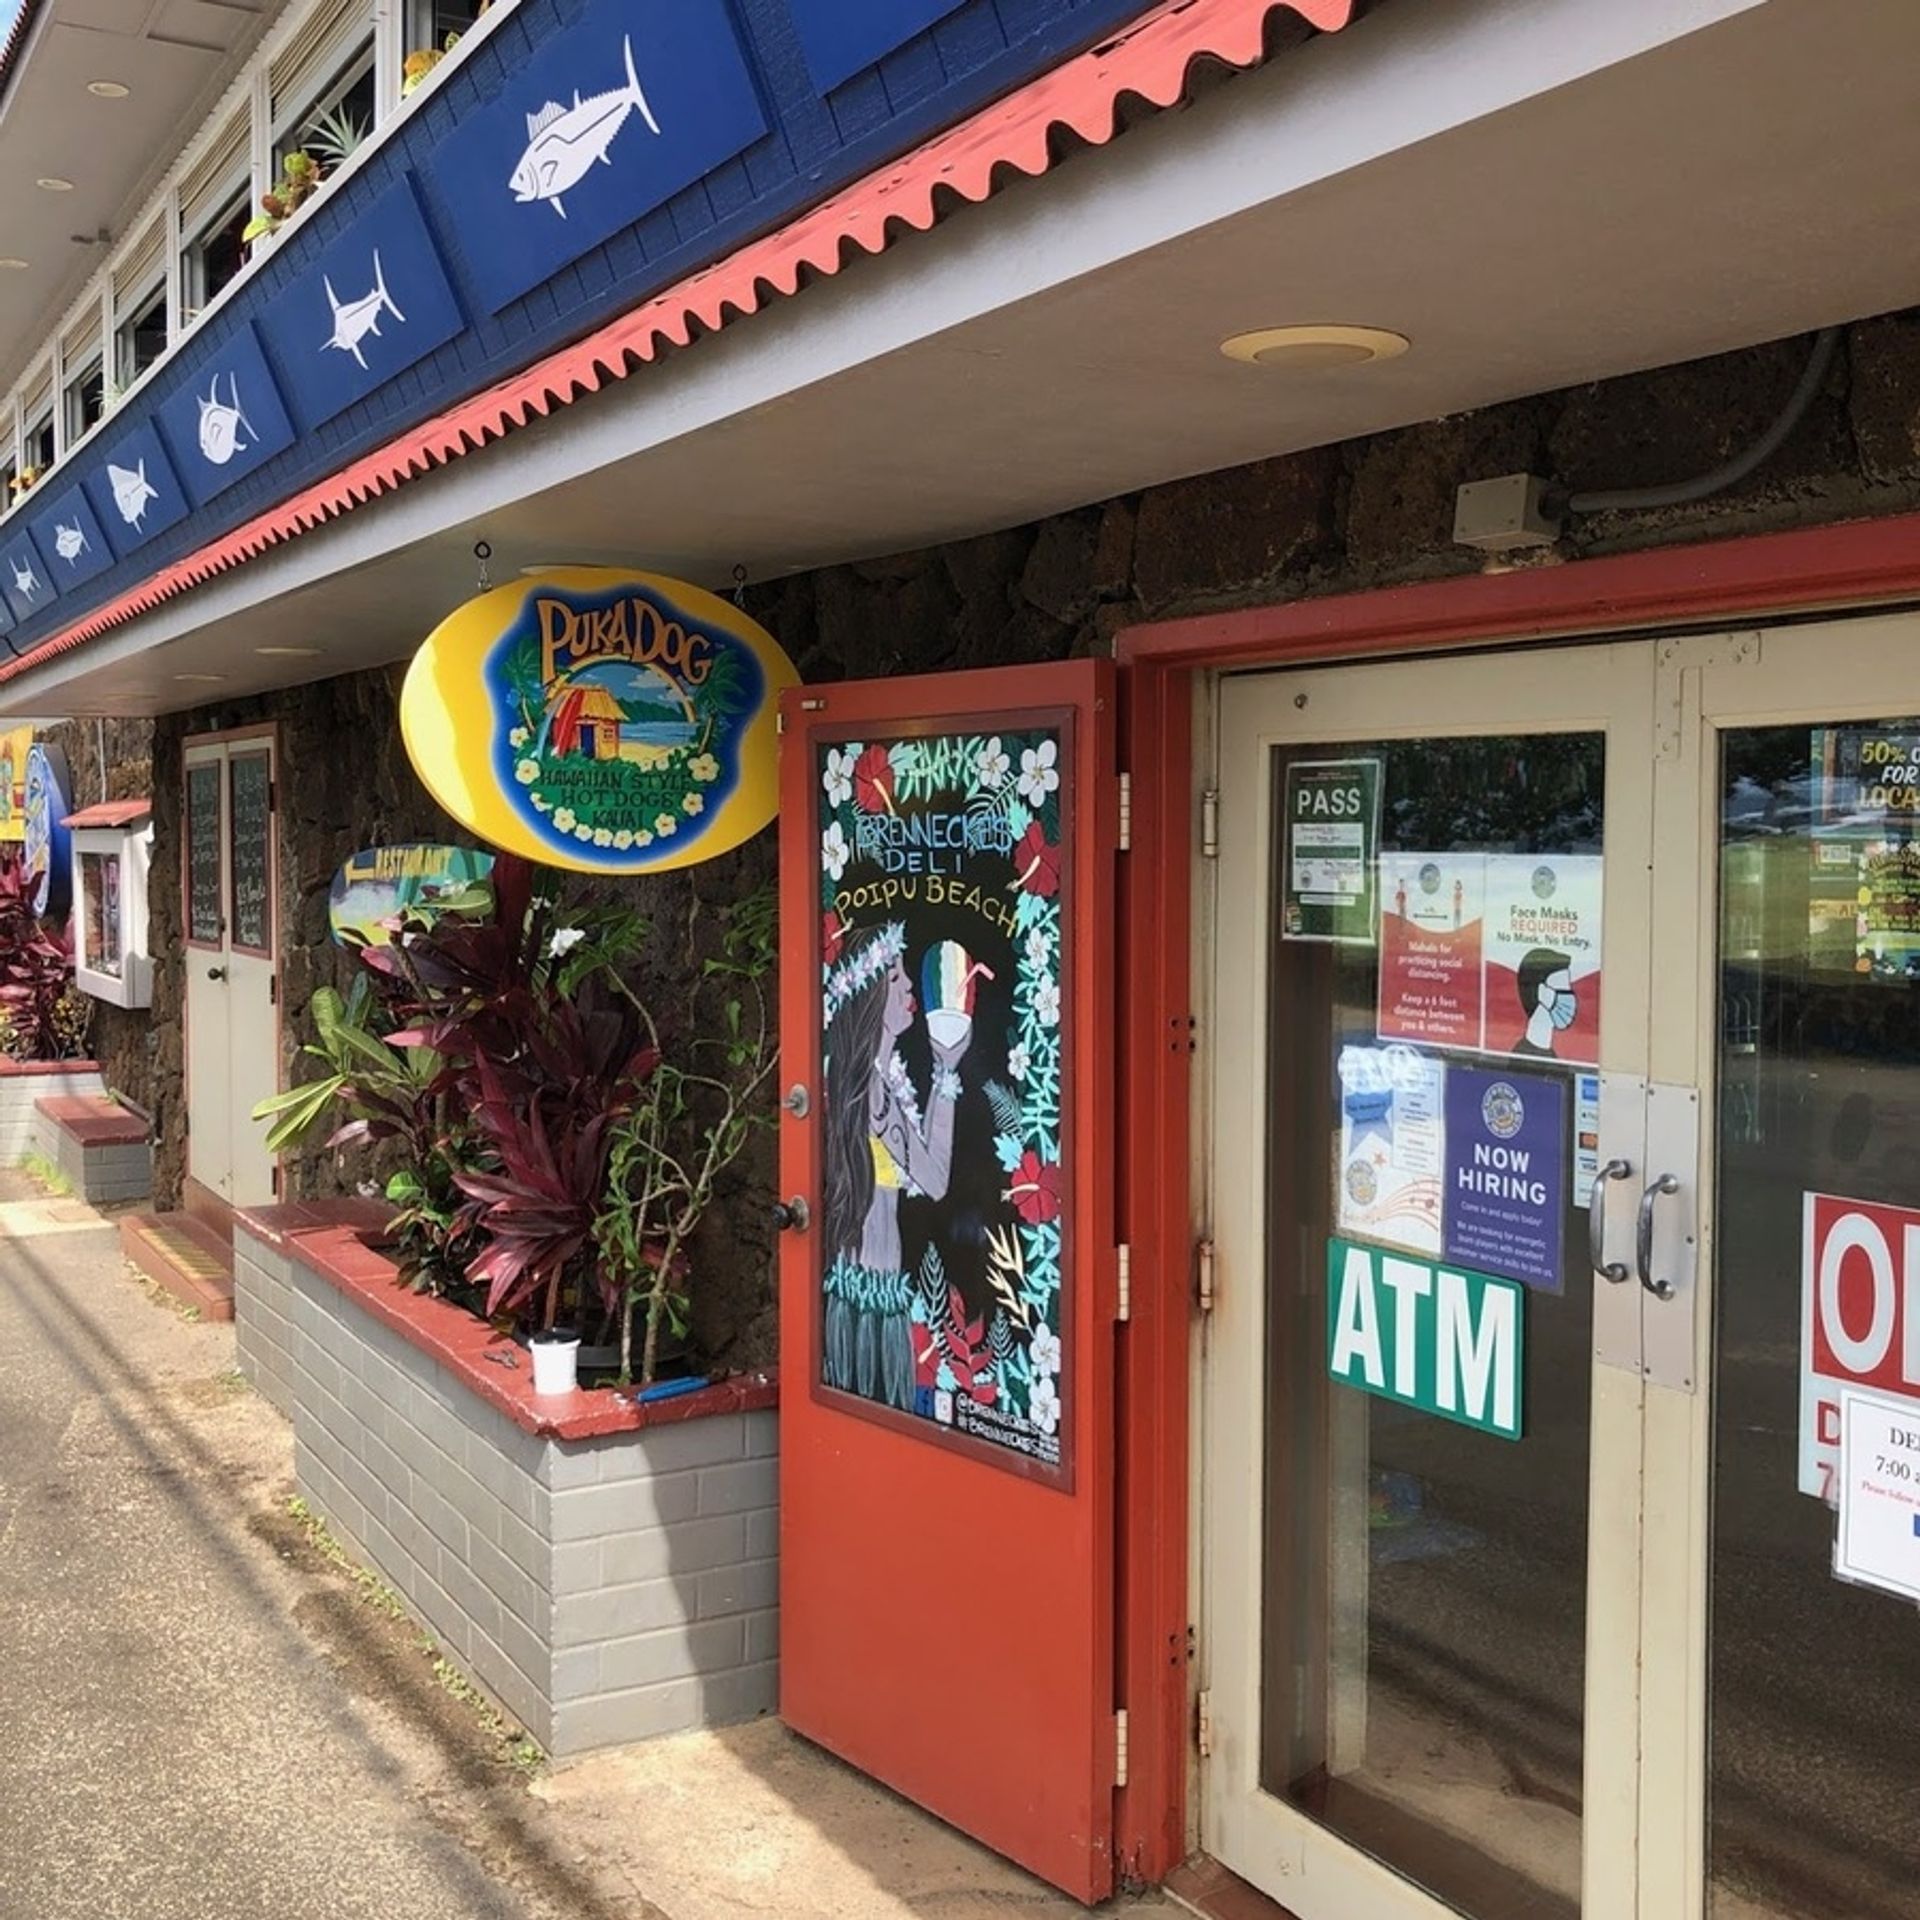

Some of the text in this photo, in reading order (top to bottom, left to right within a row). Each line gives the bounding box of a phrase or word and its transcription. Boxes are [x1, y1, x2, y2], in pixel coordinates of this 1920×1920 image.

[537, 599, 712, 686] PUKA DOG
[1862, 741, 1907, 764] 50%
[540, 769, 693, 791] HAWAIIAN STYLE
[1881, 765, 1919, 784] FOR
[561, 788, 676, 809] HOT DOGS
[1297, 787, 1361, 815] PASS
[593, 809, 645, 828] KAUAI
[885, 849, 961, 874] DELI
[834, 874, 1020, 938] POIPU BEACH
[1510, 905, 1578, 920] Face Masks
[1497, 931, 1511, 942] No
[1544, 934, 1560, 945] No
[1510, 920, 1577, 934] REQUIRED
[1475, 1143, 1530, 1173] NOW
[1459, 1167, 1546, 1205] HIRING
[1331, 1247, 1516, 1431] ATM
[1876, 1455, 1911, 1480] 7:00
